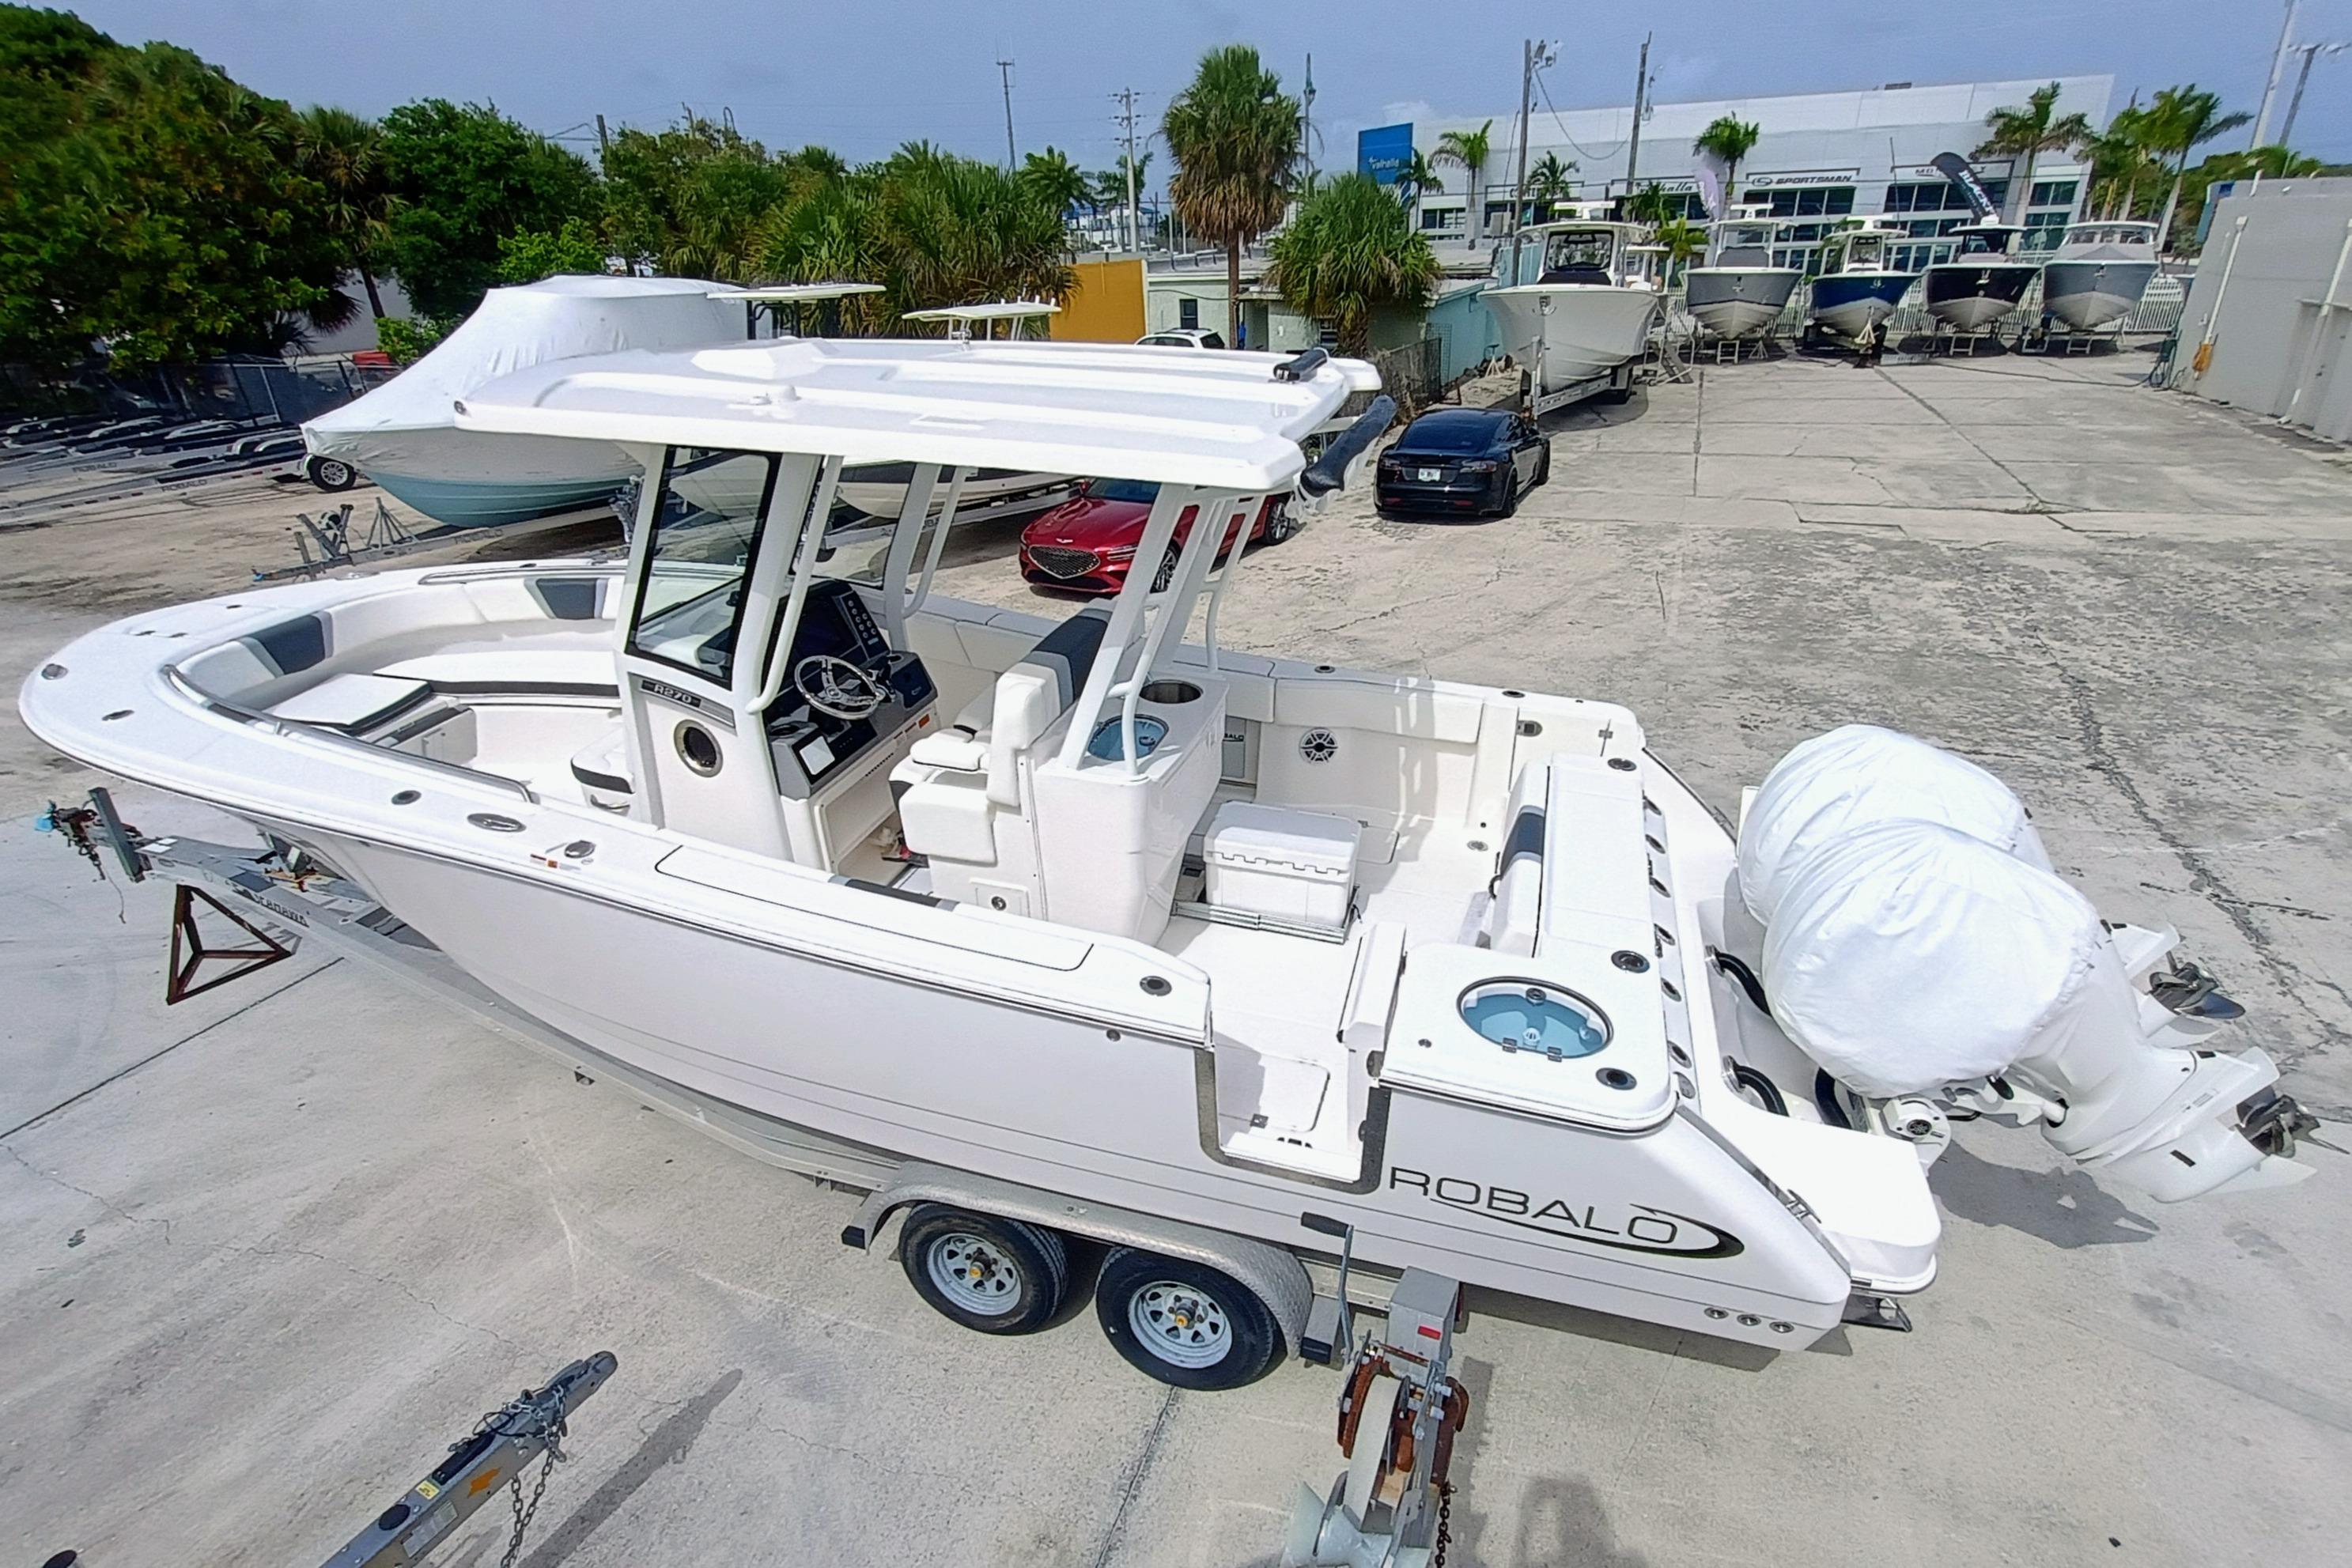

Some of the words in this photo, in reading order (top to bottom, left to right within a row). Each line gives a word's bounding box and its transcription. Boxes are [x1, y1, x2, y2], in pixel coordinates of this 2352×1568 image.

[1775, 176, 1853, 185] SPORTSMAN
[72, 462, 117, 473] ROBALO
[161, 479, 207, 492] ROBALO
[653, 684, 692, 704] R270
[1390, 1166, 1677, 1245] ROBALO
